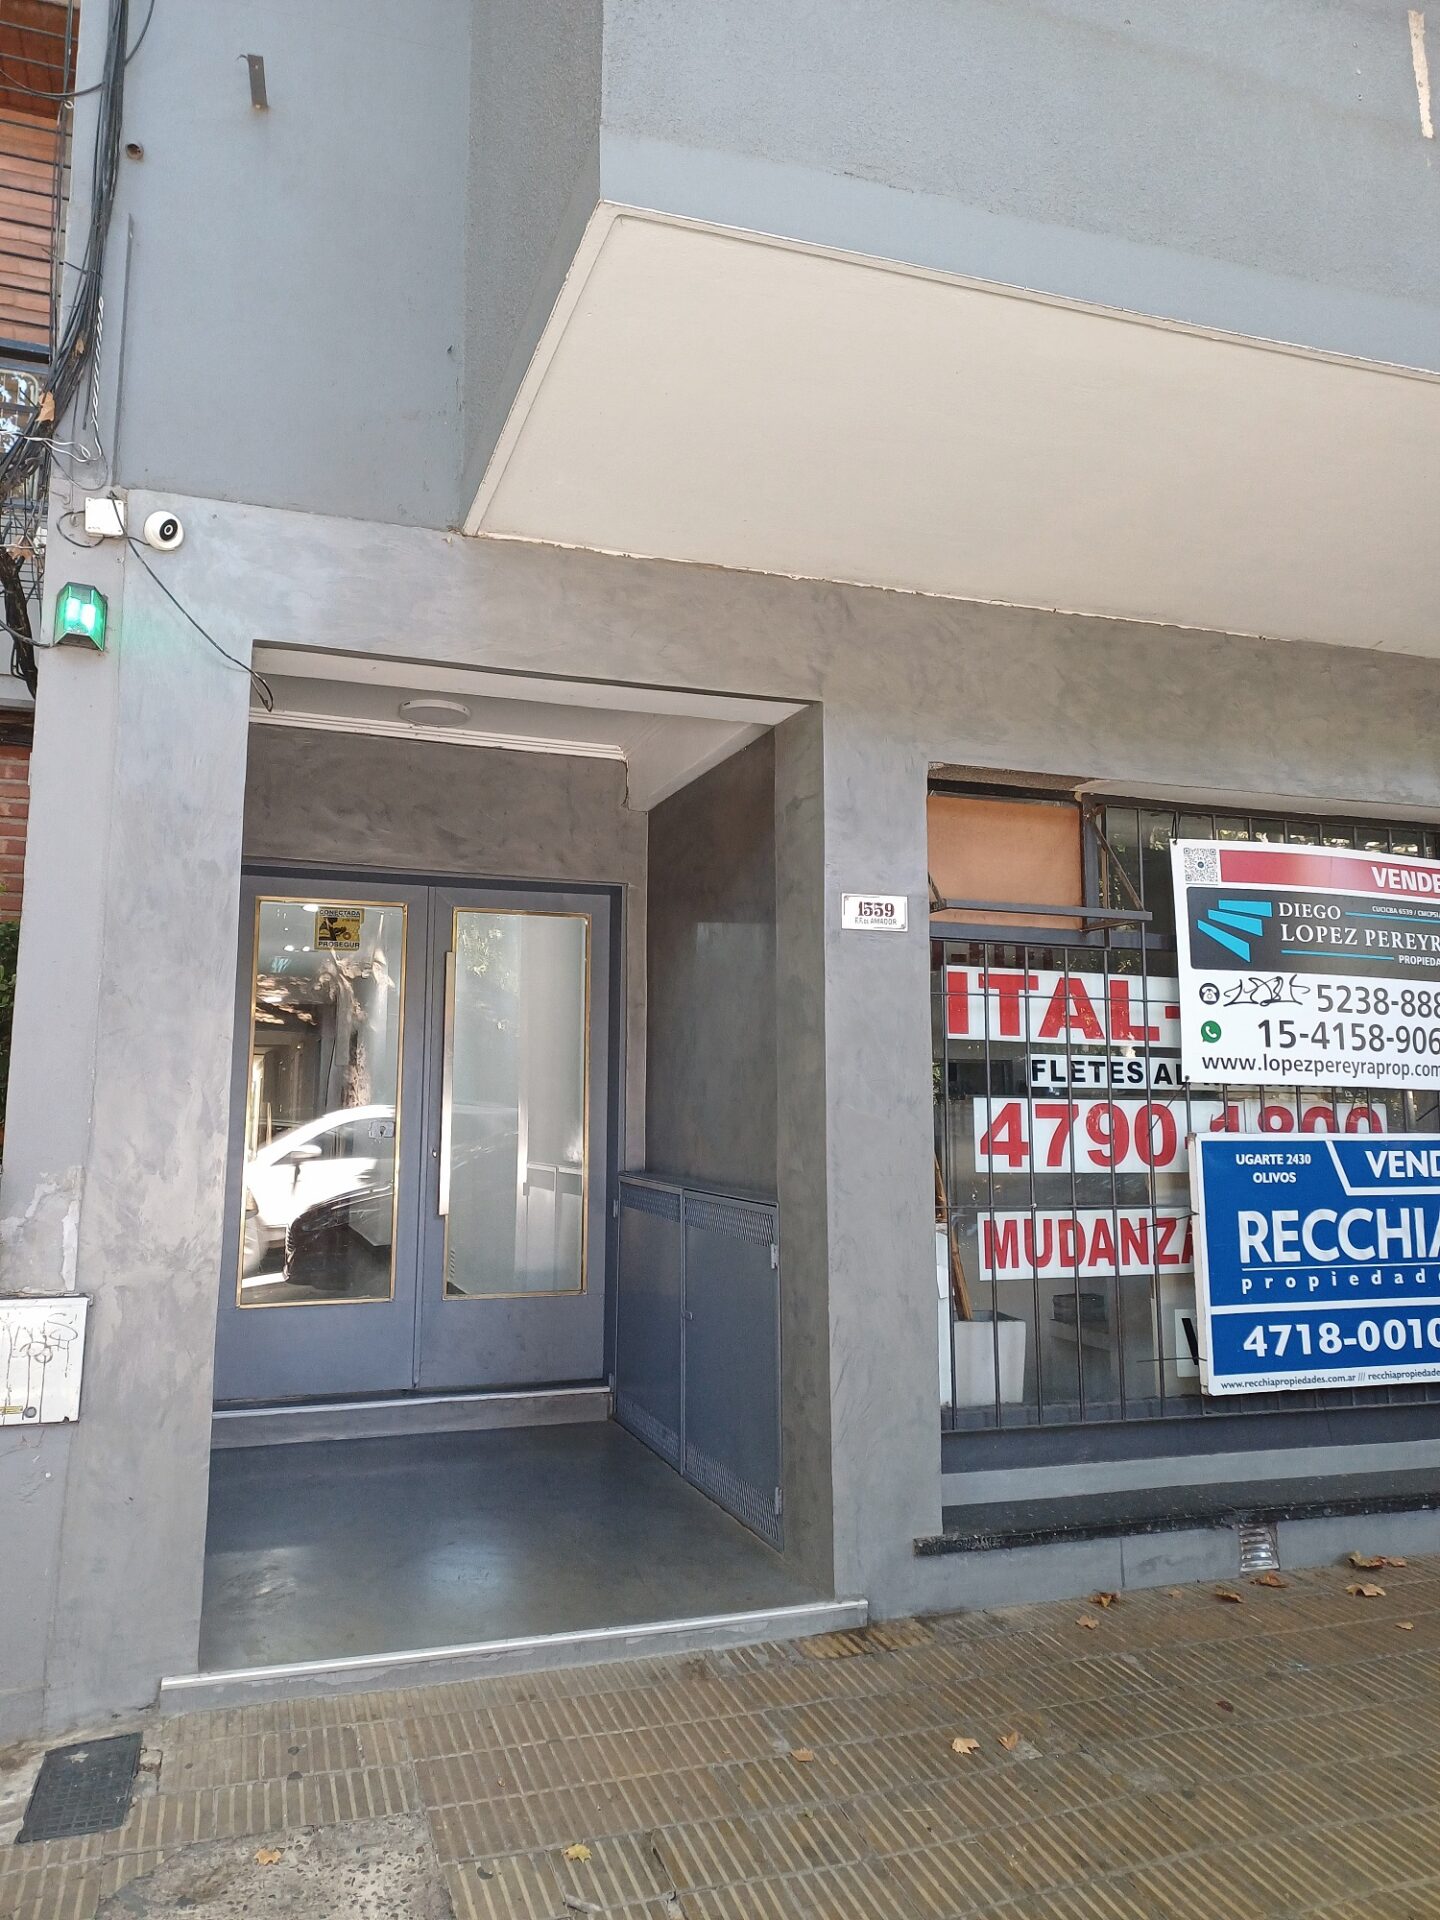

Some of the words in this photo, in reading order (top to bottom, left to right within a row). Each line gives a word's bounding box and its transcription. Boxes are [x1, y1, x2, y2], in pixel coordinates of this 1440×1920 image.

[858, 901, 895, 918] 1559
[1278, 902, 1341, 920] DIEGO
[1281, 923, 1358, 946] LOPEZ
[1031, 1058, 1145, 1084] FLETES
[1236, 1154, 1284, 1165] UGARTE
[1286, 1153, 1312, 1165] 2430
[1253, 1172, 1297, 1184] OLIVOS
[1237, 1207, 1440, 1264] RECCHI
[1242, 1267, 1440, 1294] propiedad
[1220, 1373, 1356, 1390] www.recchiapropiedades.com.ar
